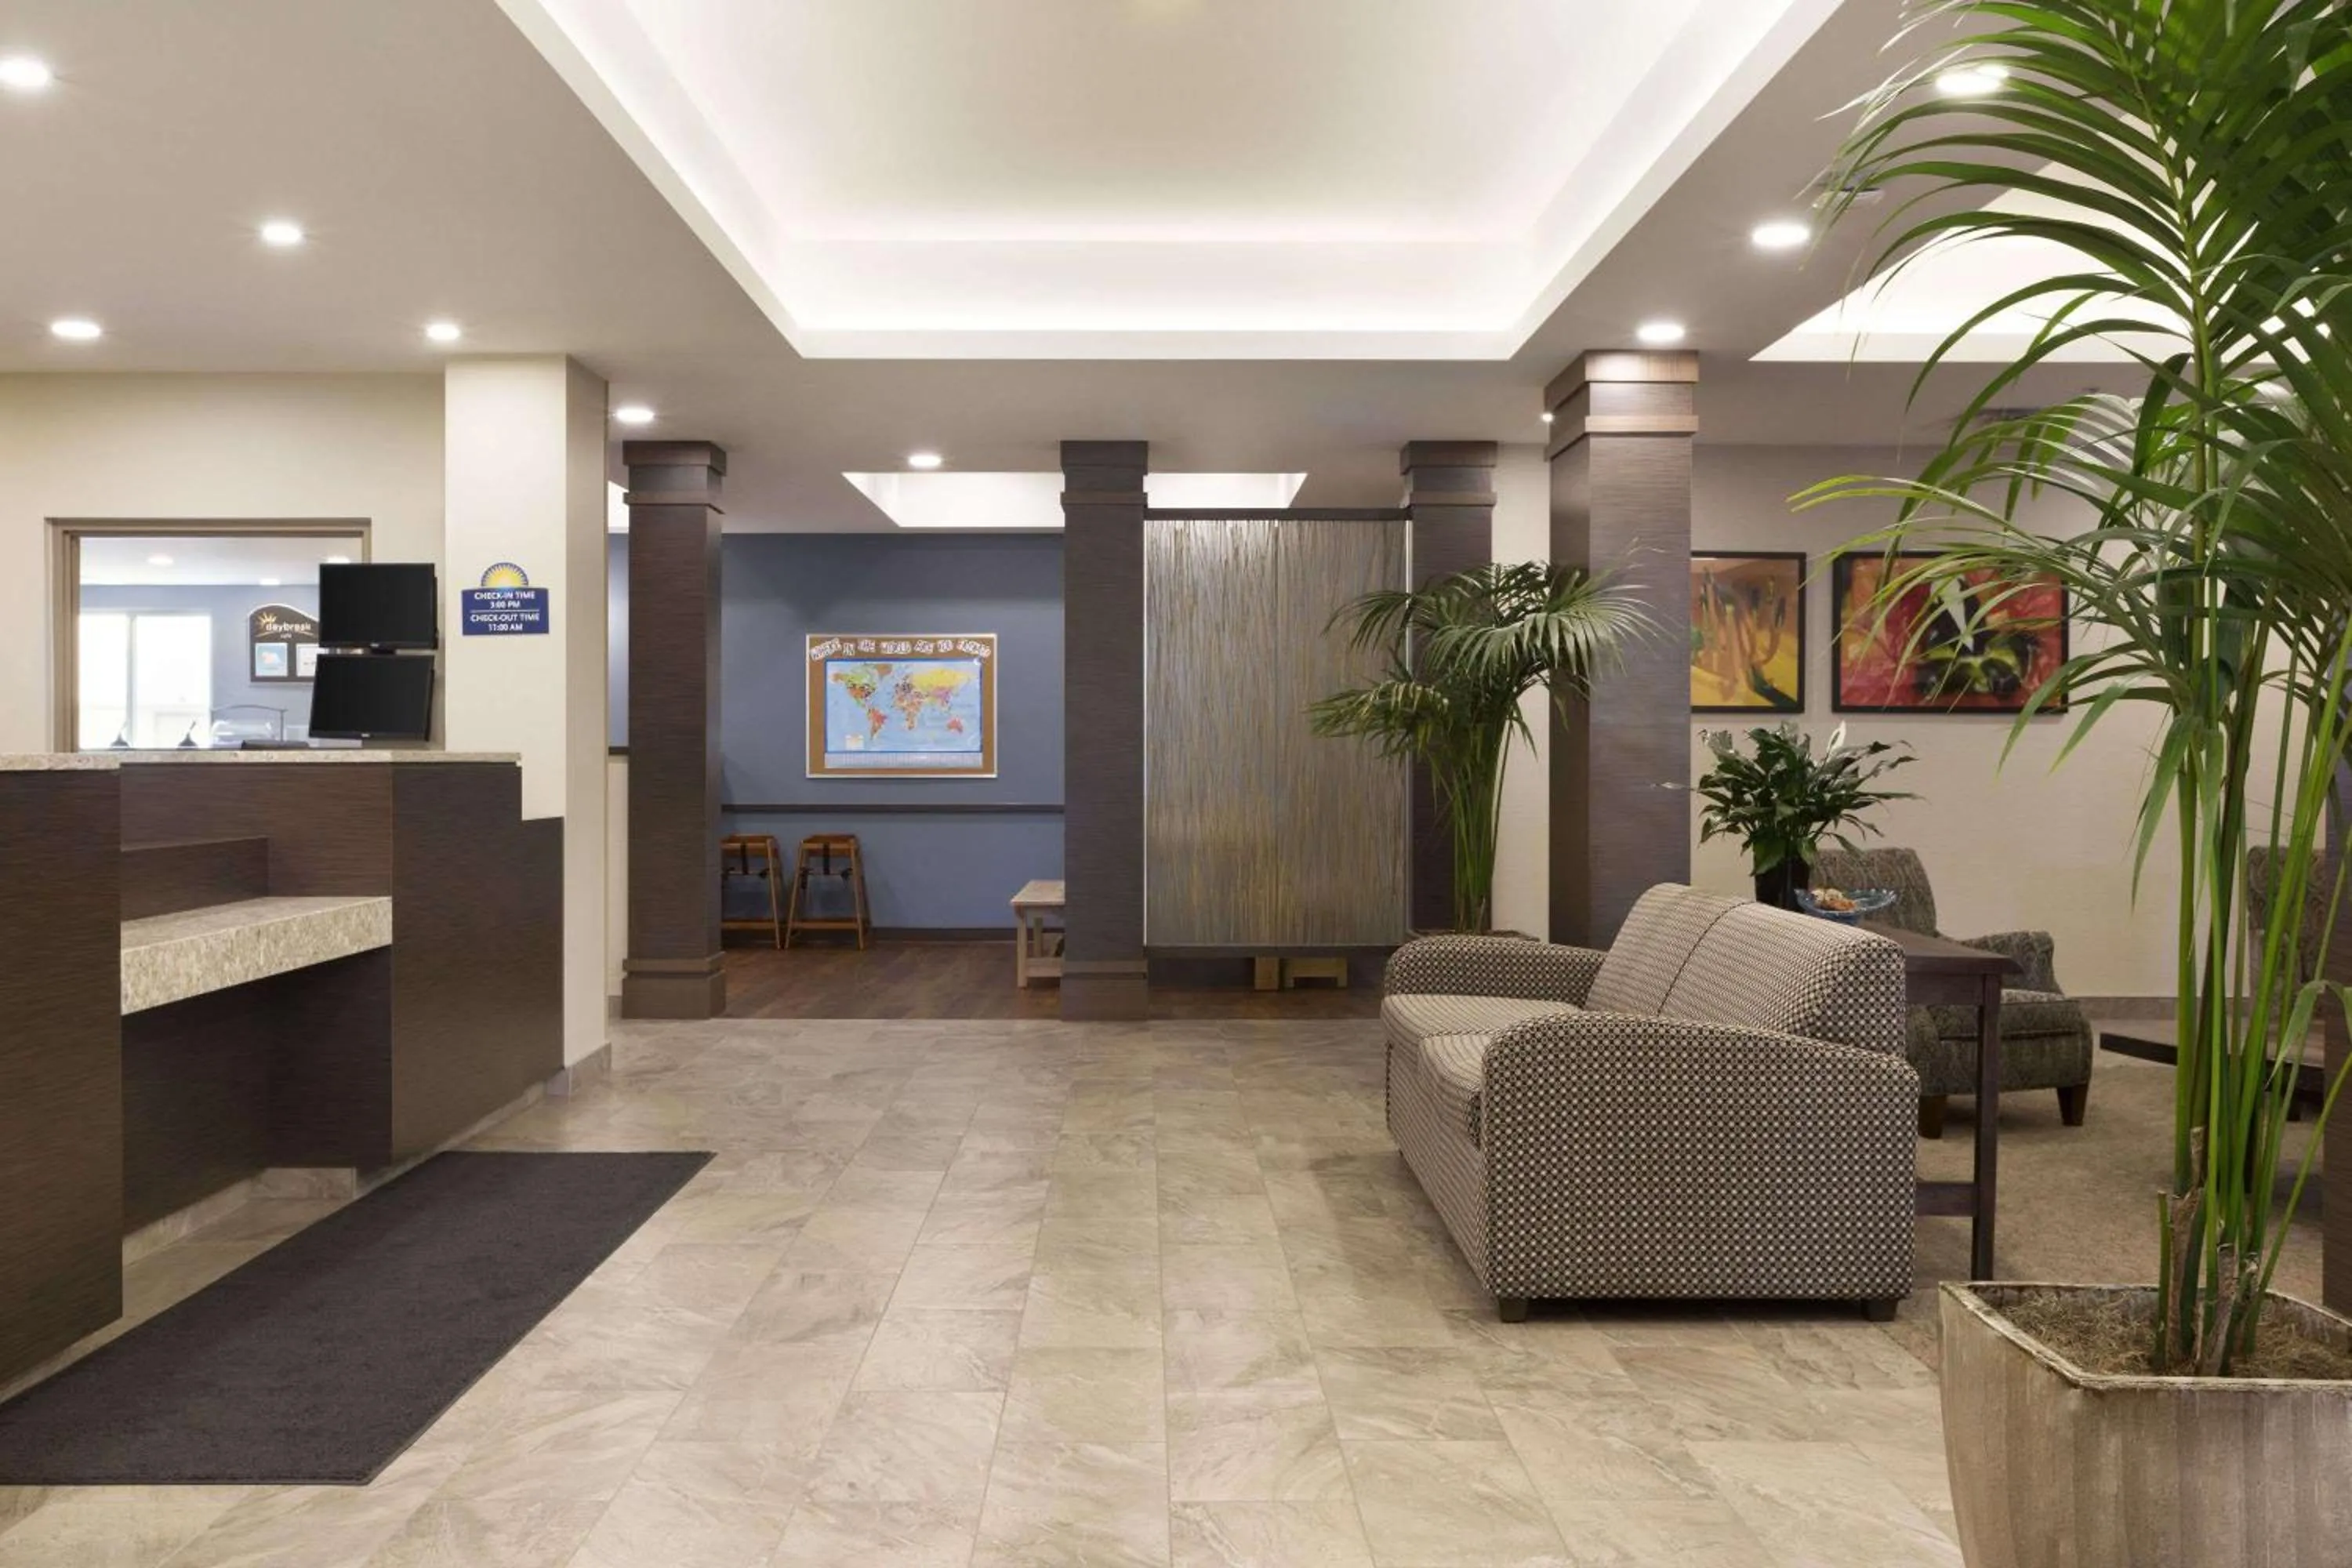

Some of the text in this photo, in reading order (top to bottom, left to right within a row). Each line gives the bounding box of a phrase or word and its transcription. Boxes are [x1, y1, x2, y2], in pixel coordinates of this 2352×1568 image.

[515, 590, 535, 600] TIME
[507, 600, 521, 608] PM
[519, 612, 539, 621] TIME
